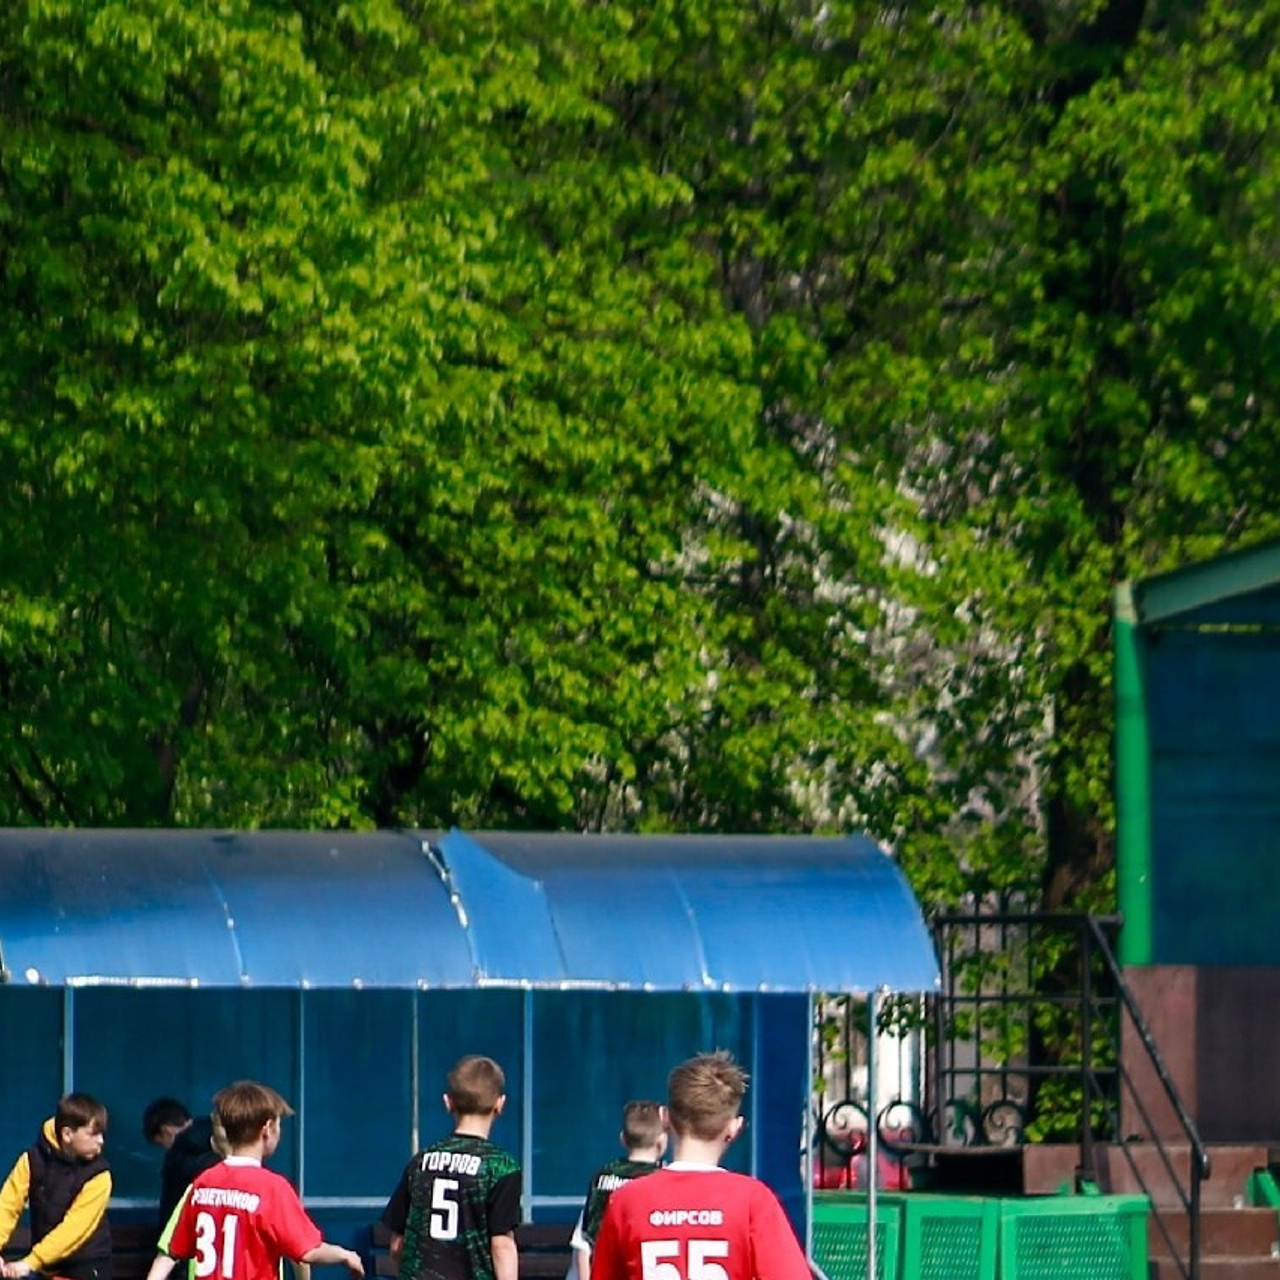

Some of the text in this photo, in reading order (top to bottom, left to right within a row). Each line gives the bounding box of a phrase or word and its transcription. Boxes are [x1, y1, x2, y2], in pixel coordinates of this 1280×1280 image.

[422, 1152, 481, 1175] ГОРЛОВ
[430, 1177, 459, 1240] 5
[649, 1209, 723, 1227] ФИРСОВ
[195, 1211, 238, 1279] 31
